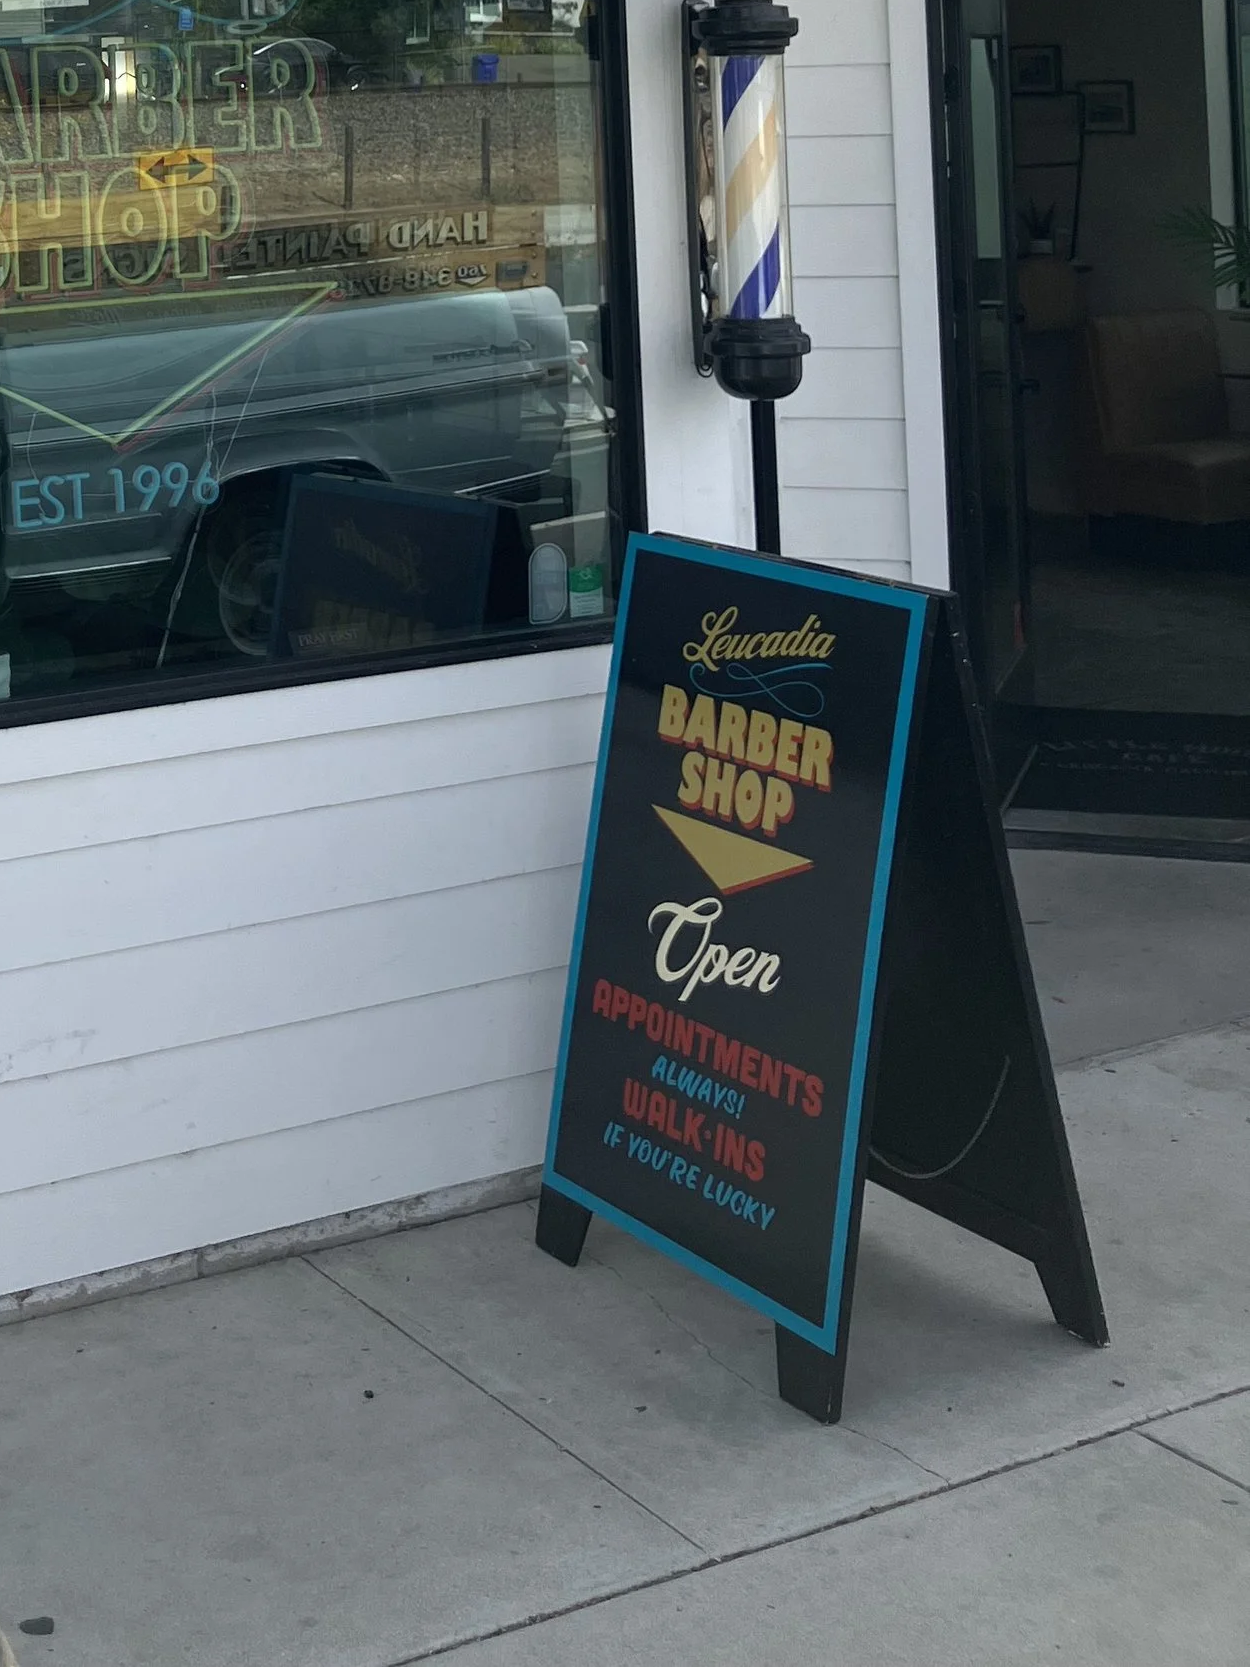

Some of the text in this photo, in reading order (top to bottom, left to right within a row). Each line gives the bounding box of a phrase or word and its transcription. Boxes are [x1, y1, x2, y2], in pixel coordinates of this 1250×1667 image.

[11, 460, 221, 529] EST 1996
[682, 605, 836, 672] Leucadia
[657, 684, 835, 792] BARBER
[676, 750, 795, 837] SHOP
[647, 896, 781, 1002] Open
[592, 979, 825, 1118] APPOINTMENTS
[651, 1054, 746, 1120] ALWAYS!
[602, 1121, 776, 1232] IF YOU'RE LUCKY
